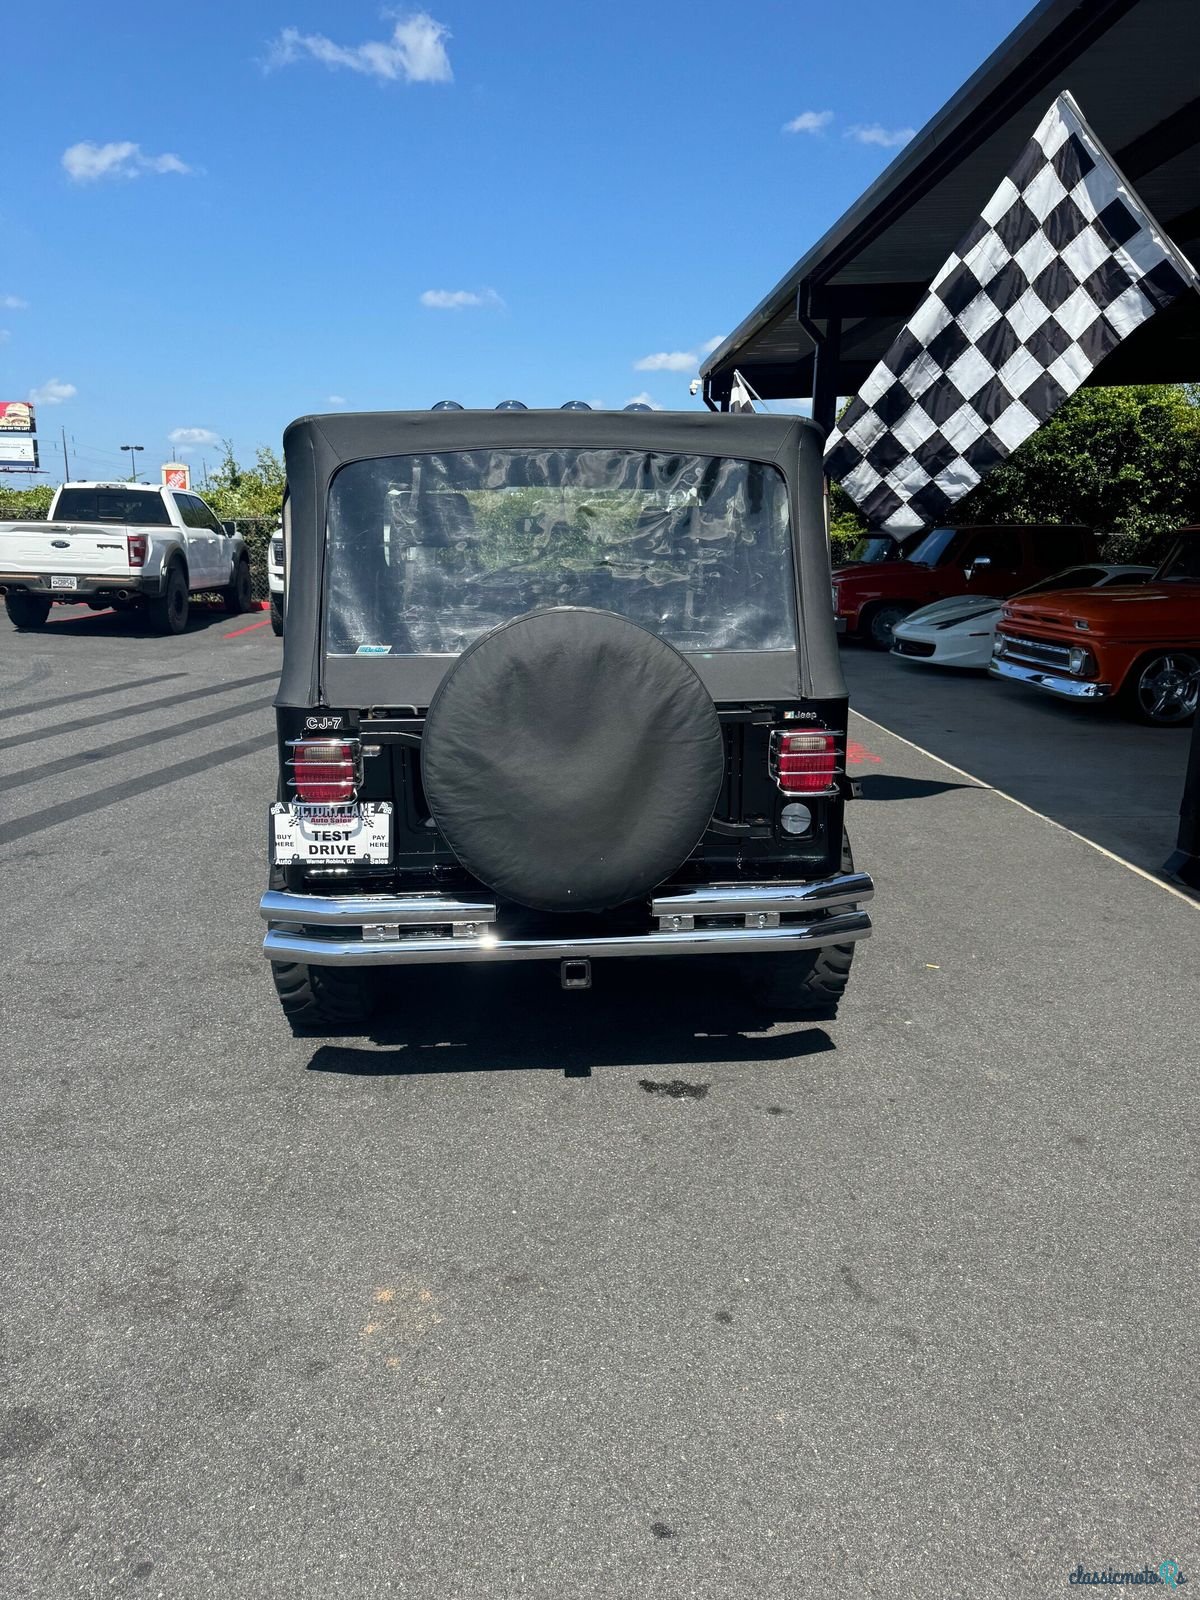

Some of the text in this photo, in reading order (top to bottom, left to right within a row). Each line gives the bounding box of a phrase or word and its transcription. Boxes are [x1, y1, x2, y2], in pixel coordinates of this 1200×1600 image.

[794, 711, 817, 720] Jeep
[306, 717, 342, 730] CJ-7
[311, 831, 352, 841] TEST
[308, 845, 357, 855] DRIVE
